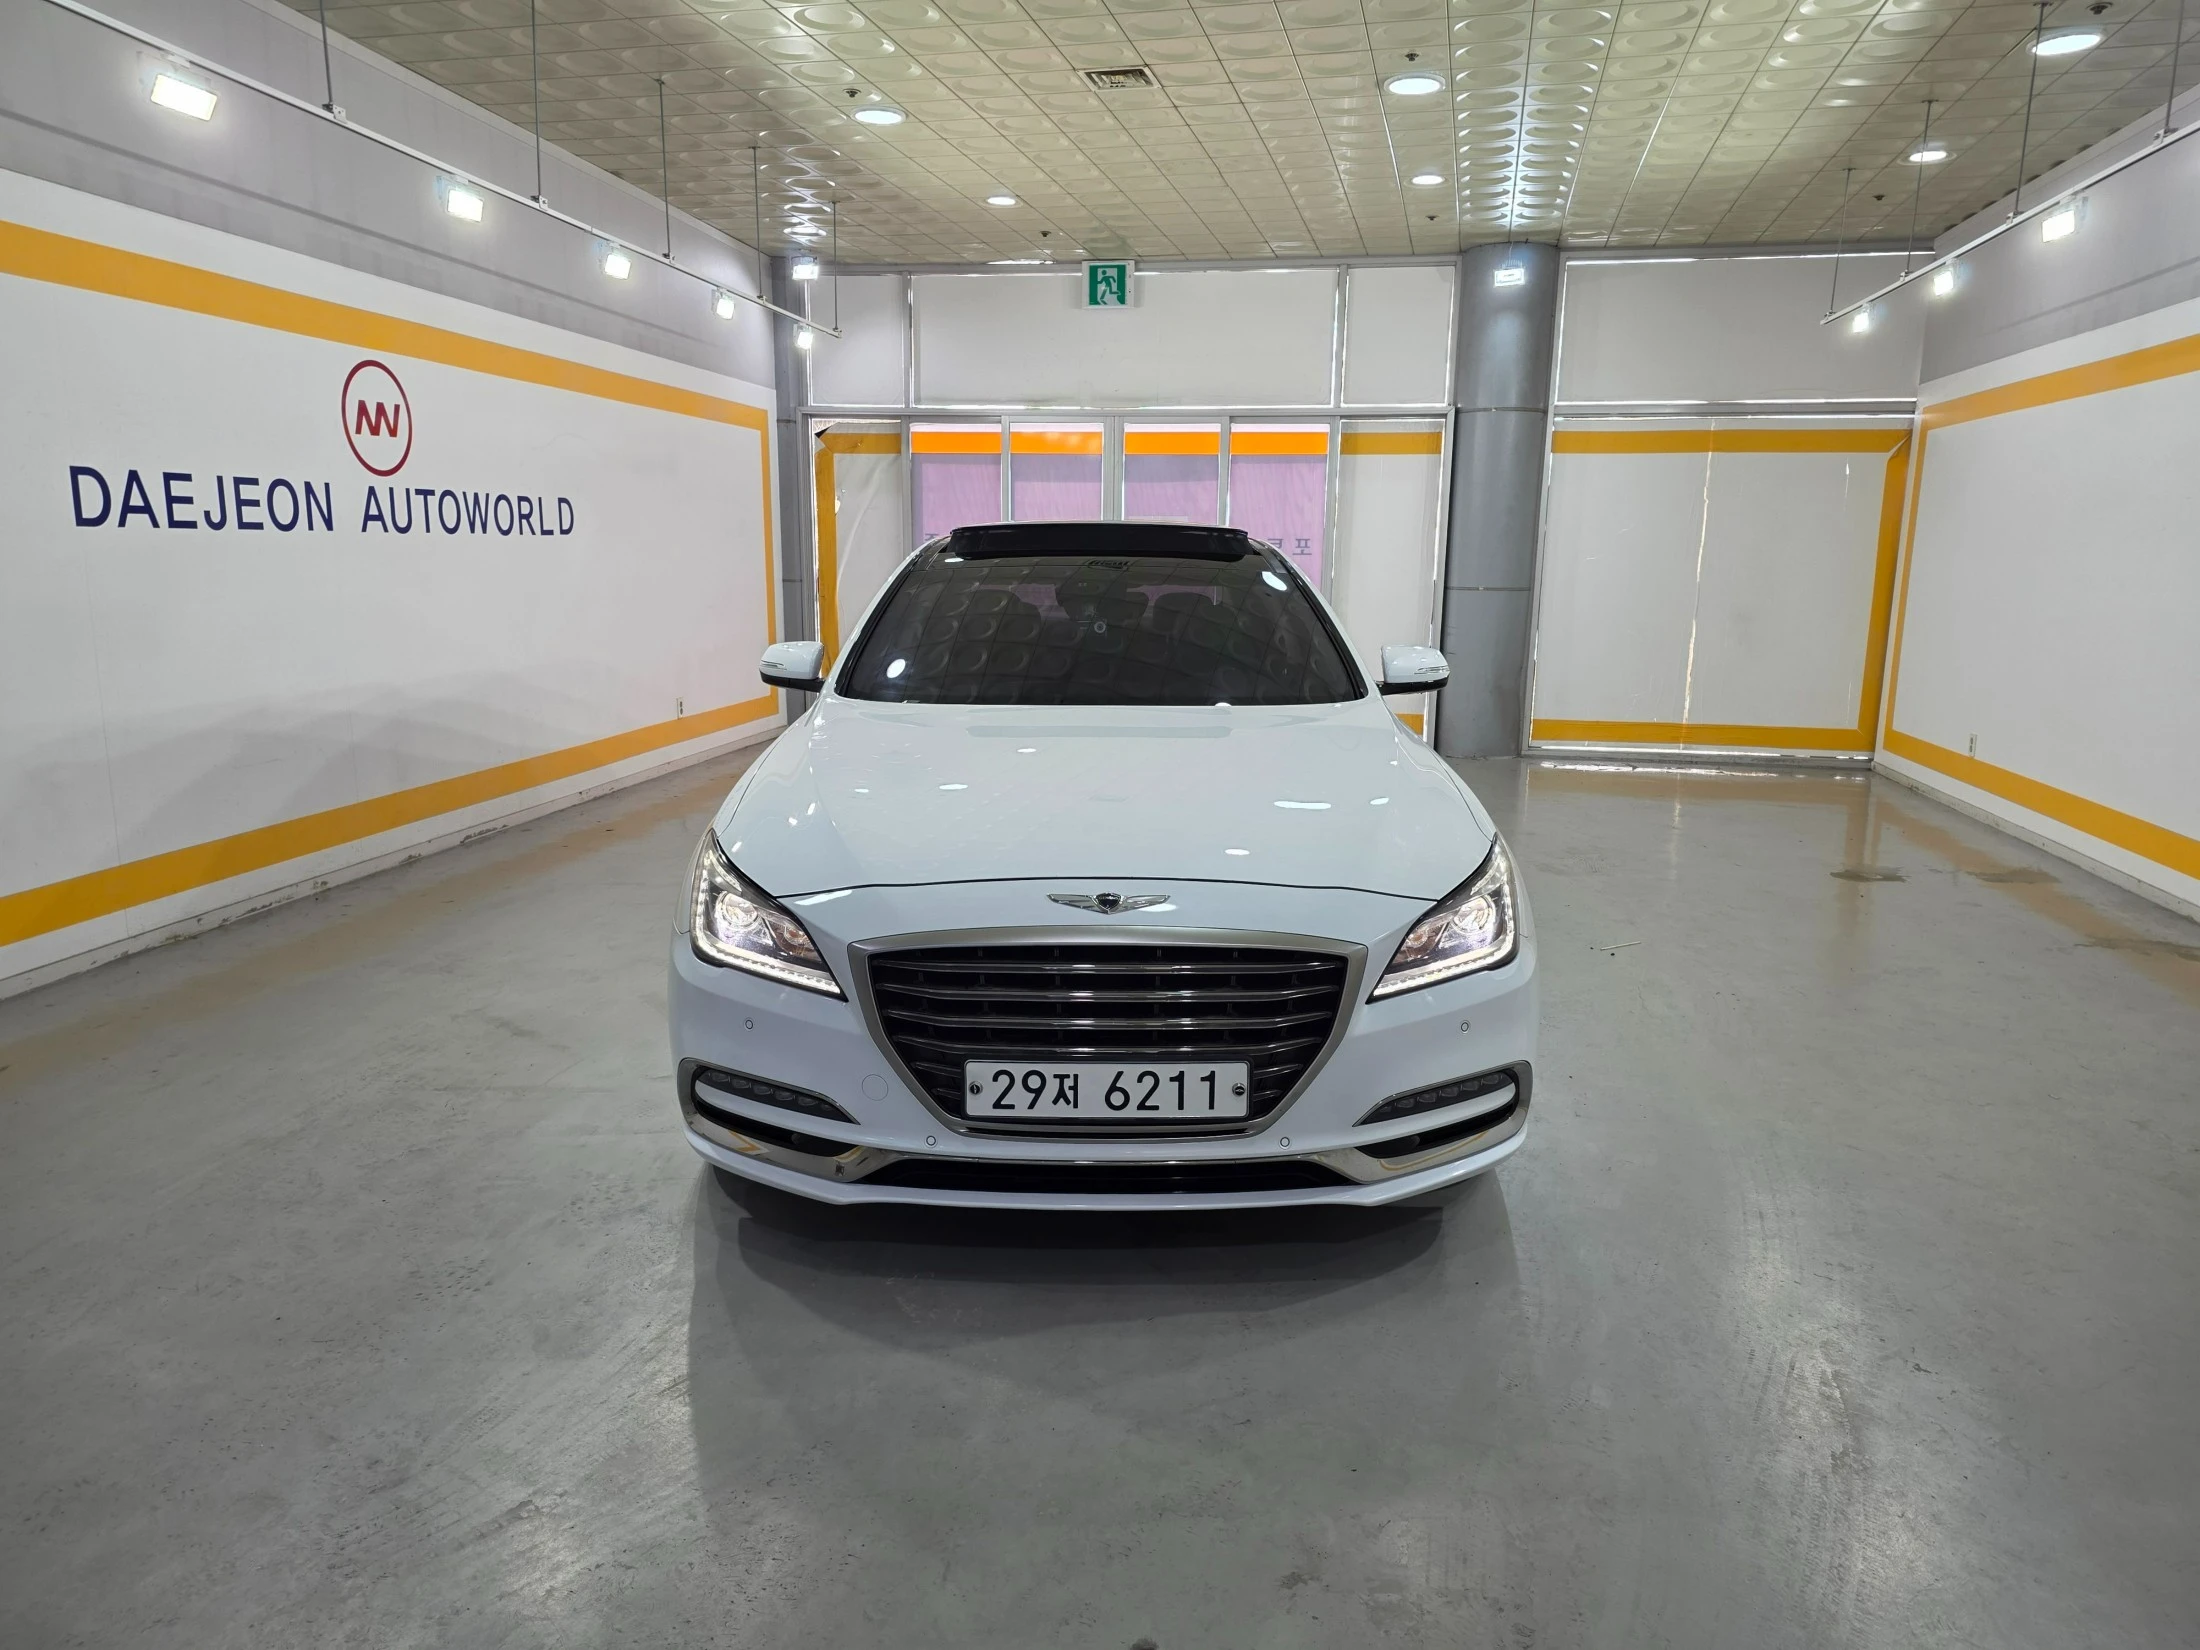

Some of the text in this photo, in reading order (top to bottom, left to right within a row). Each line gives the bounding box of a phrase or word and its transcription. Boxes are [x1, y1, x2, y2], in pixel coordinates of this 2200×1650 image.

[70, 466, 573, 536] DAEJEON AUTOWORLD
[992, 1070, 1215, 1111] 29저 6211
